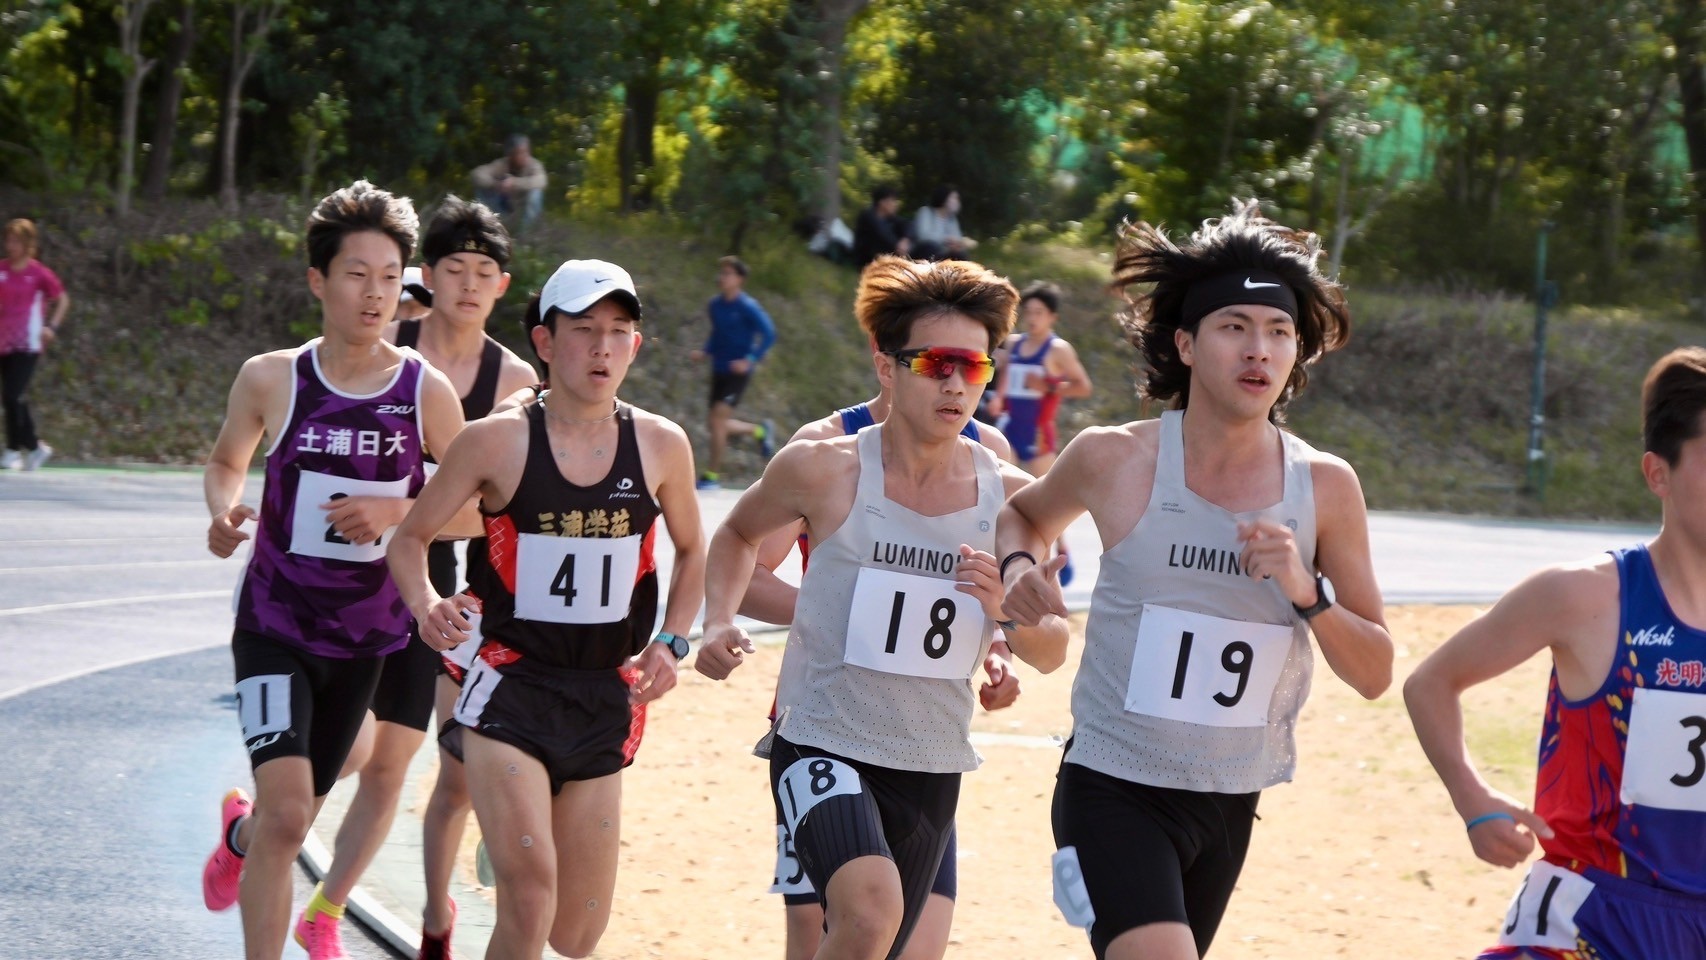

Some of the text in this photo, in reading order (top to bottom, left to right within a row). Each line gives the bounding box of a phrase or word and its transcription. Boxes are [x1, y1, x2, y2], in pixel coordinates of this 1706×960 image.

[296, 426, 409, 457] 土浦日大
[549, 553, 612, 607] 41
[873, 541, 961, 575] LUMINO
[1168, 544, 1271, 580] LUMIN
[885, 591, 956, 659] 18
[1171, 631, 1254, 708] 19
[1655, 657, 1706, 688] 光明
[235, 682, 269, 736] 1
[1669, 715, 1706, 788] 3
[784, 759, 837, 821] 18
[774, 832, 805, 885] 5
